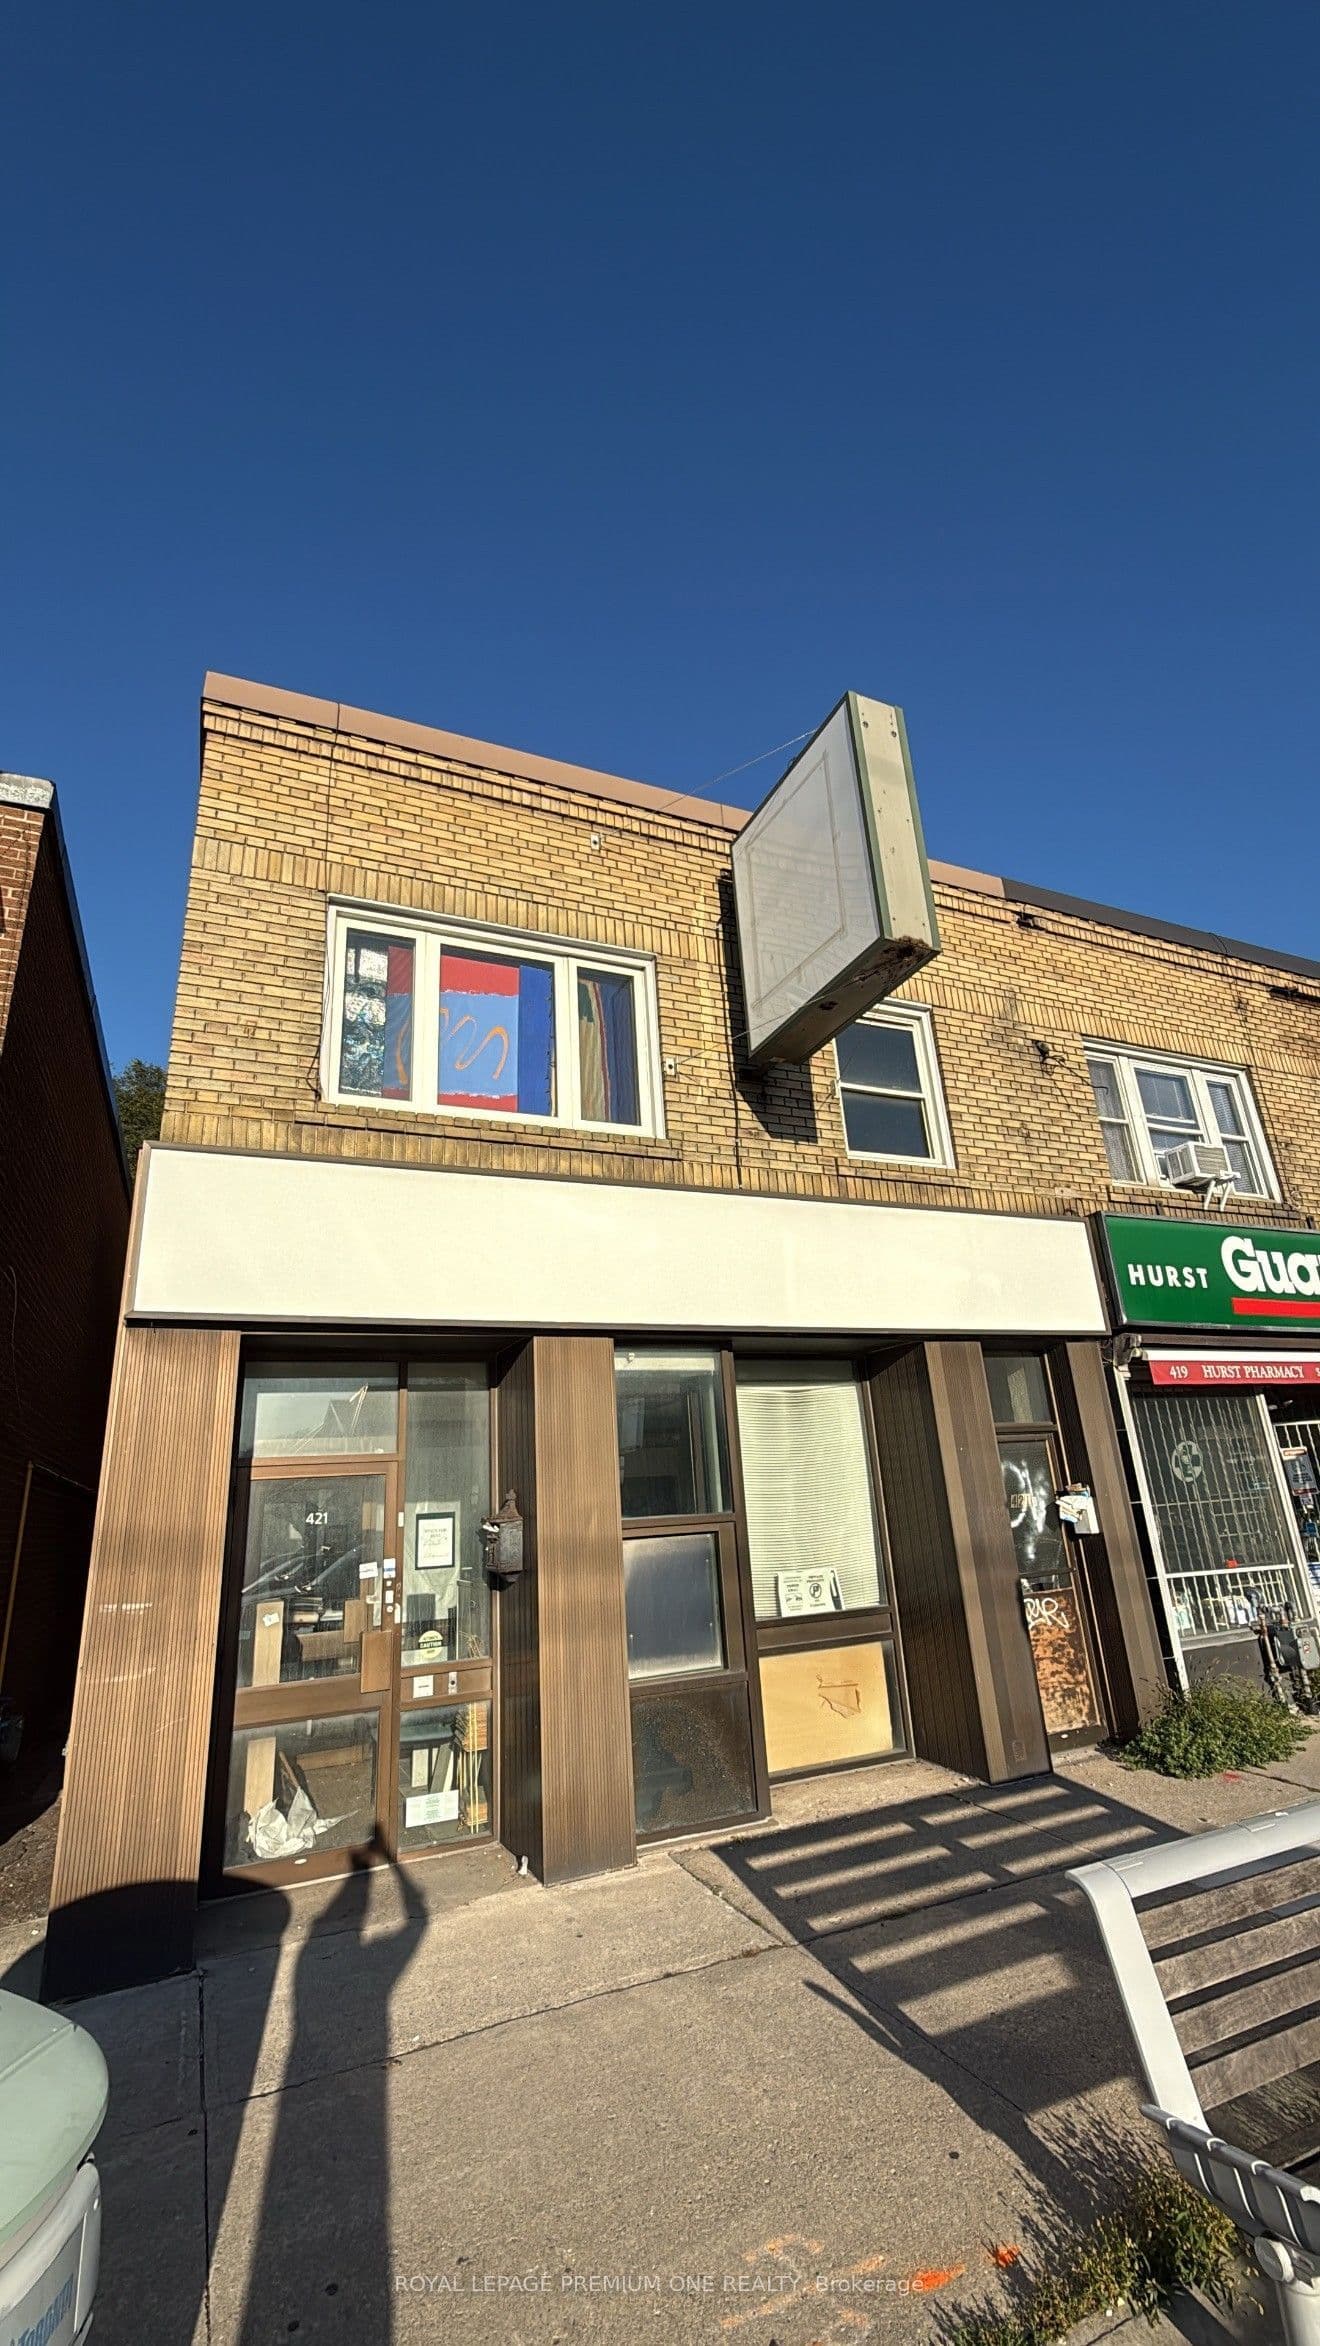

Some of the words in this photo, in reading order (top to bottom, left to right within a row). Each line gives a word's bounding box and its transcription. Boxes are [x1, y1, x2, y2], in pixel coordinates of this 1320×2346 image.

[1127, 1263, 1208, 1289] HURST
[1220, 1235, 1320, 1296] Gua
[1169, 1365, 1188, 1379] 419
[1201, 1364, 1241, 1379] HURST
[1242, 1365, 1305, 1379] PHARMACY
[305, 1511, 328, 1525] 421
